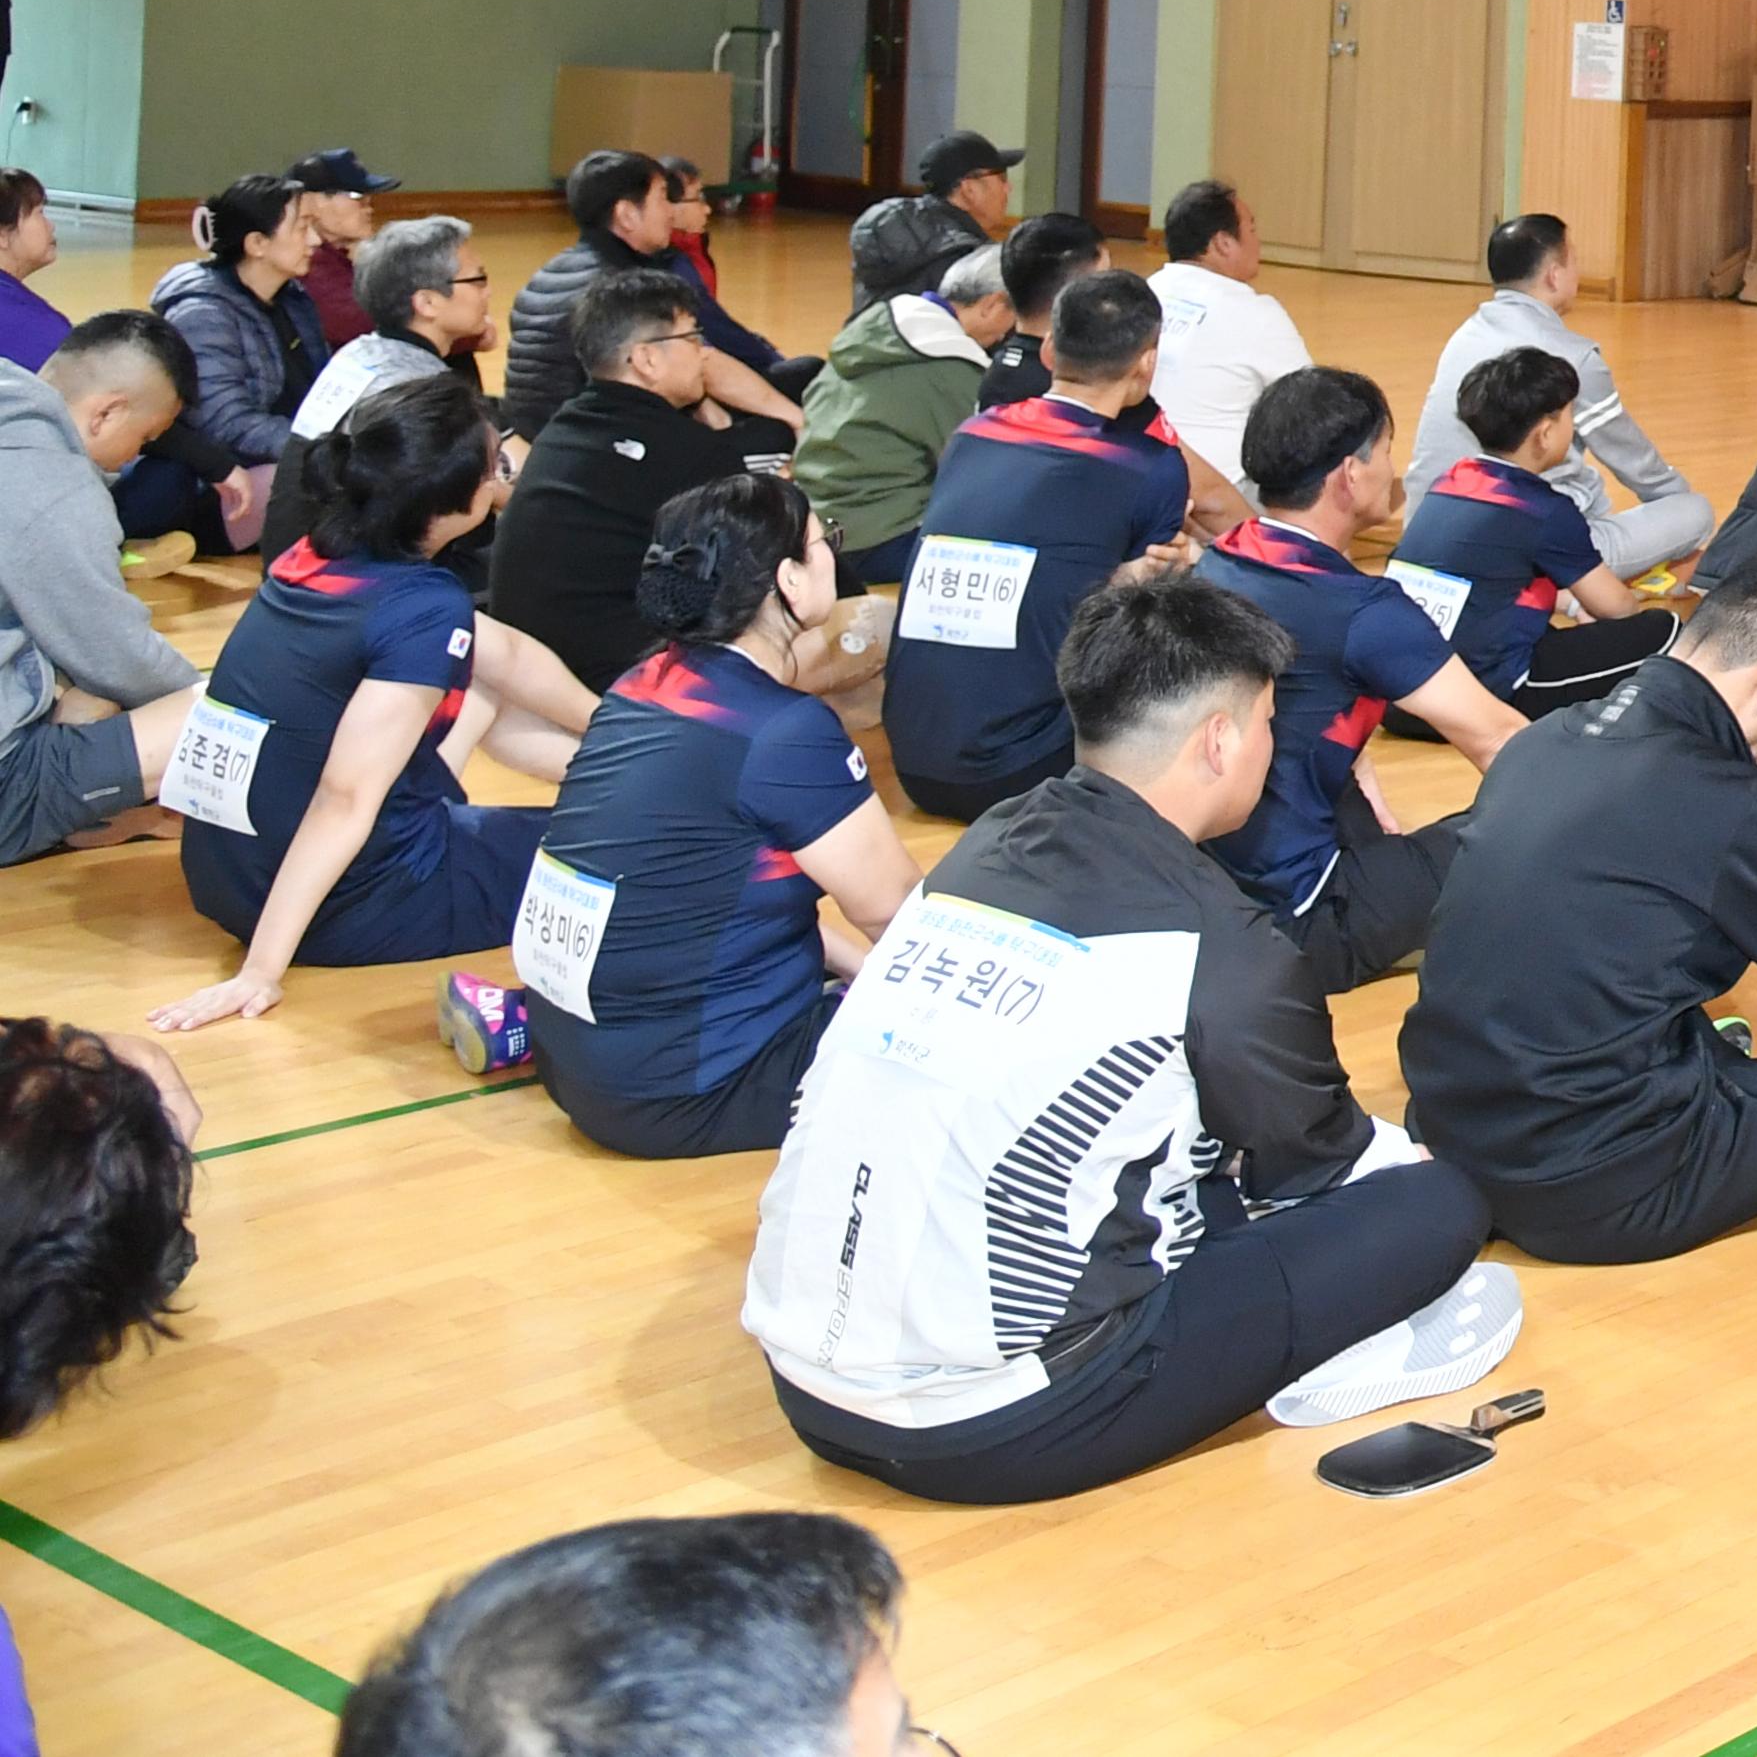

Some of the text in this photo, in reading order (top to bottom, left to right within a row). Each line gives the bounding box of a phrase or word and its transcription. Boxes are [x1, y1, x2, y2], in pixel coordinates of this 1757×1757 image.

[916, 566, 1018, 604] 서형민(6)
[883, 939, 1045, 1026] 김녹원(7)
[840, 1161, 872, 1271] CLASS
